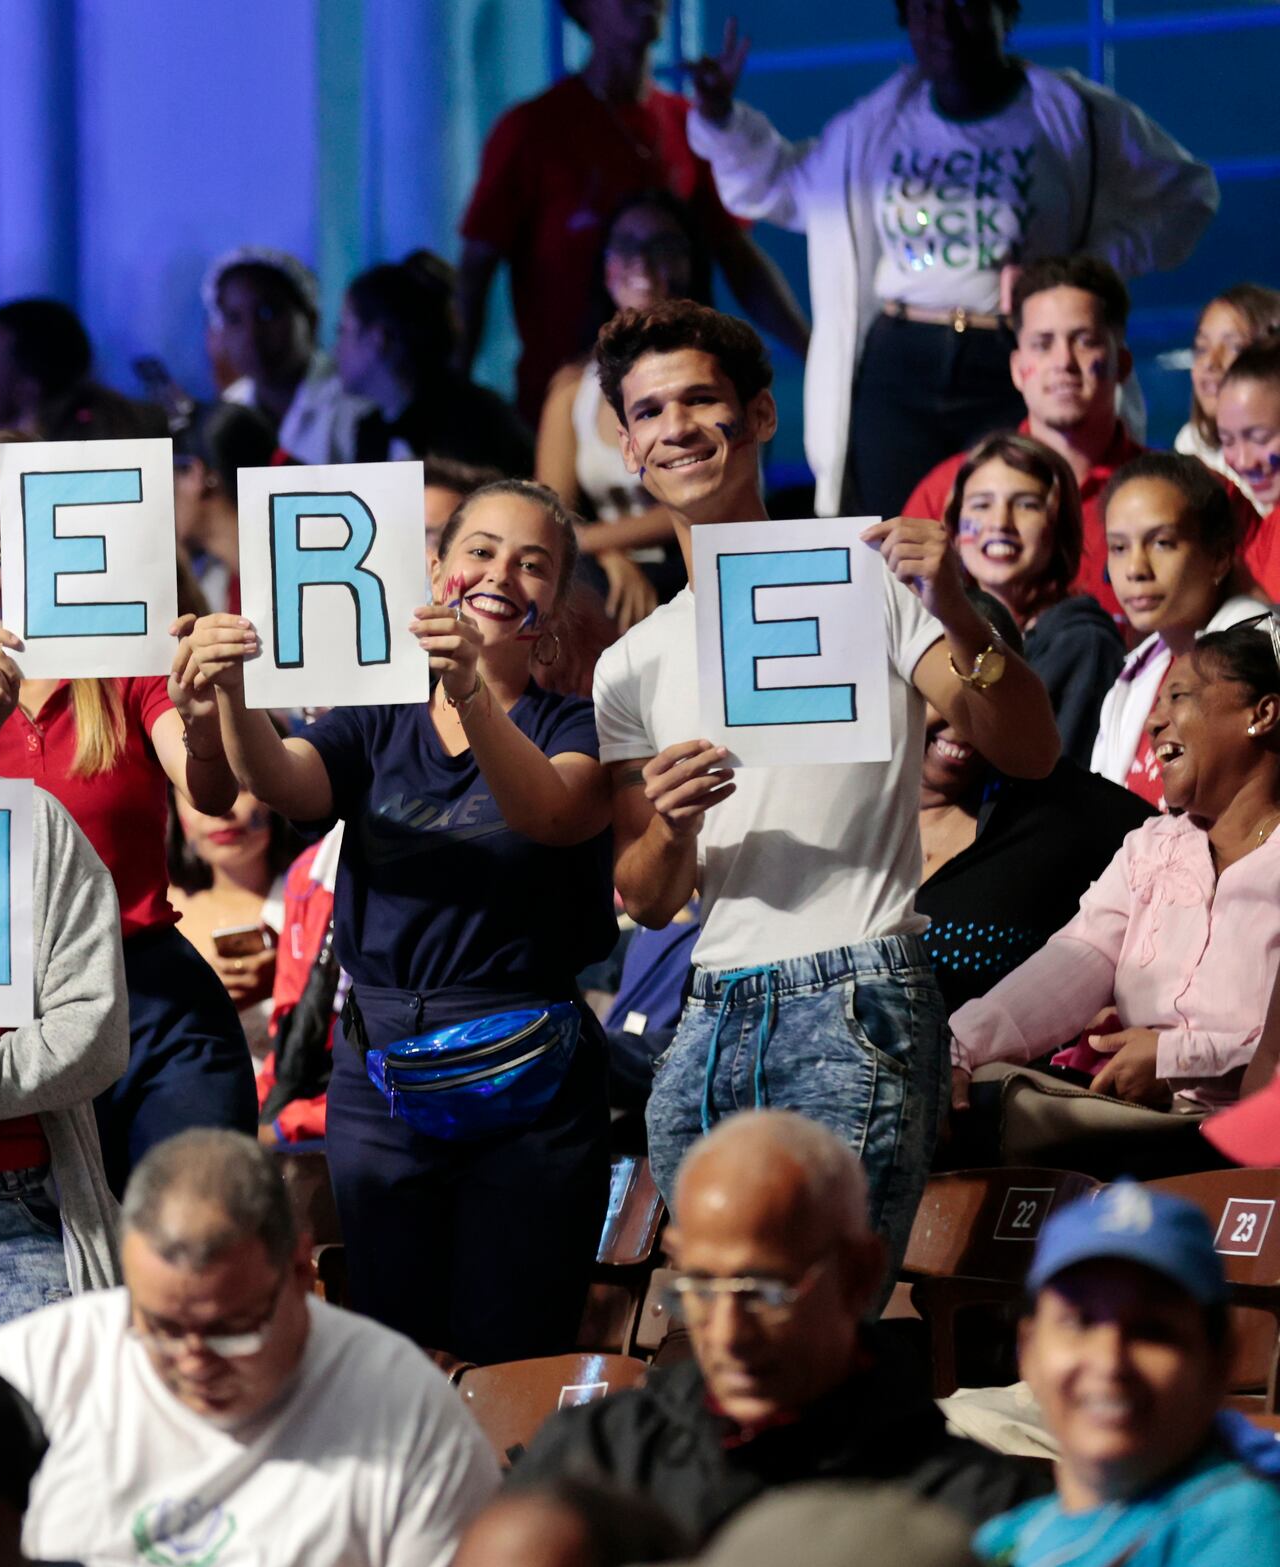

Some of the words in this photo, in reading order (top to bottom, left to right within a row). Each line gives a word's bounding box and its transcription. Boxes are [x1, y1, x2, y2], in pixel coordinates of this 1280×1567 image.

[717, 547, 857, 727] E
[379, 793, 490, 830] NIKE
[1012, 1202, 1037, 1228] 22
[1230, 1212, 1257, 1242] 23
